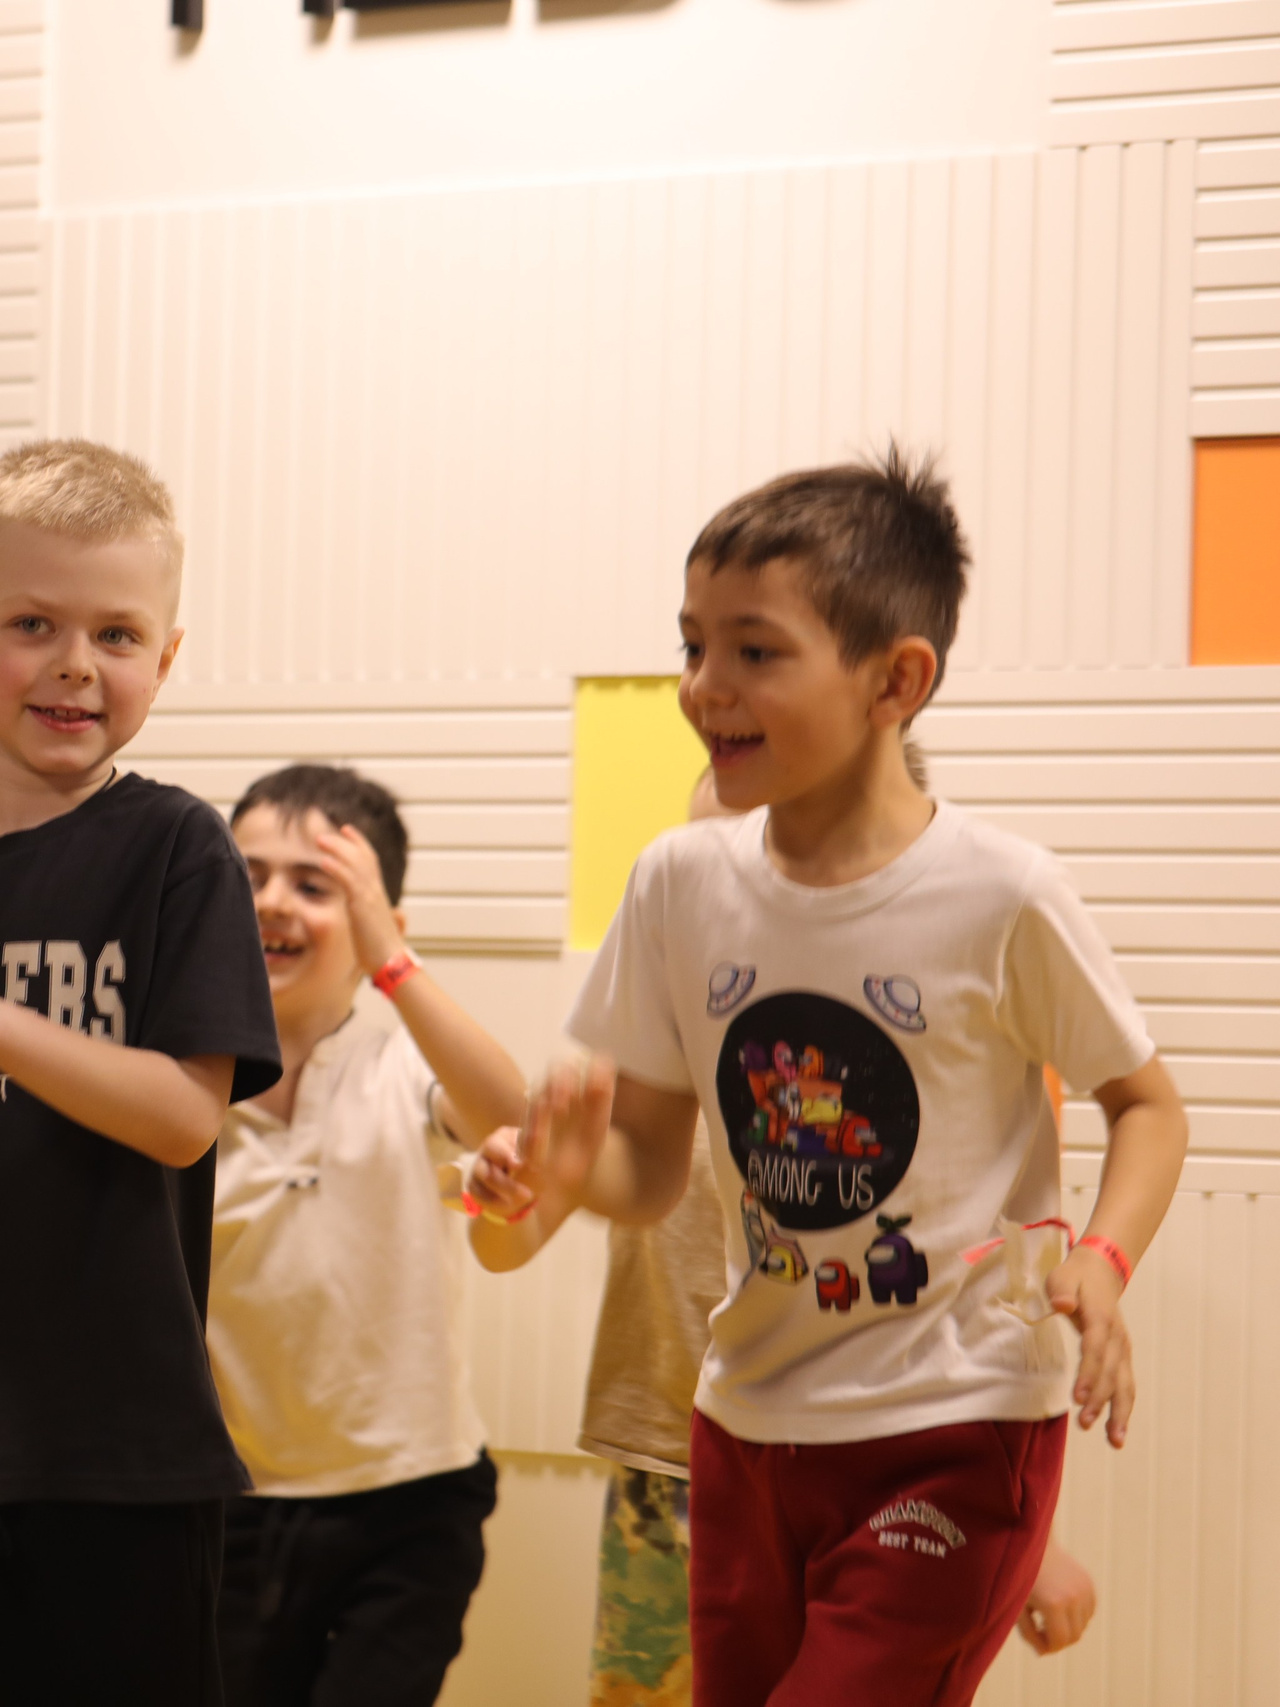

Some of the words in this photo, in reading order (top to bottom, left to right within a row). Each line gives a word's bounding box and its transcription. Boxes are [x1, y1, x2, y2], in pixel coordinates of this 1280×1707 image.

[747, 1148, 822, 1206] AMONG
[838, 1161, 874, 1211] US
[878, 1530, 909, 1550] BEST
[914, 1535, 946, 1558] TEAM
